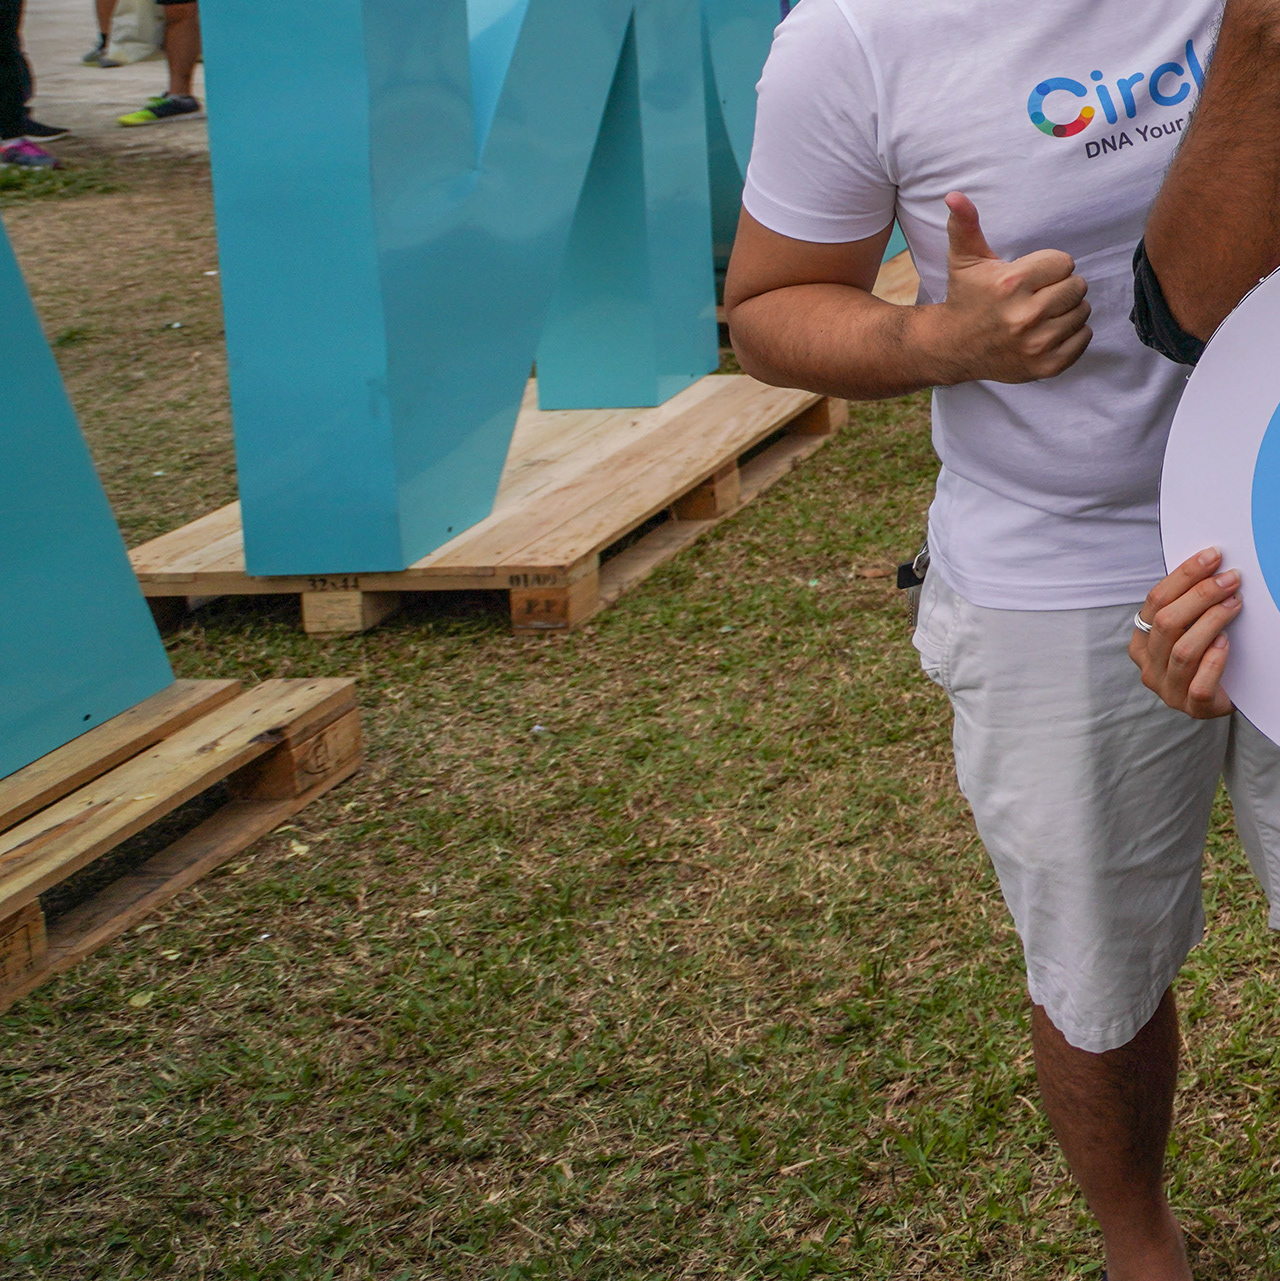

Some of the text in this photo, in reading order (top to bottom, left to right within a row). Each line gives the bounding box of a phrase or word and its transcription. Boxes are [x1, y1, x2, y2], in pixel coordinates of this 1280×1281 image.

[1027, 38, 1208, 138] Circl
[1085, 118, 1185, 159] DNA Your
